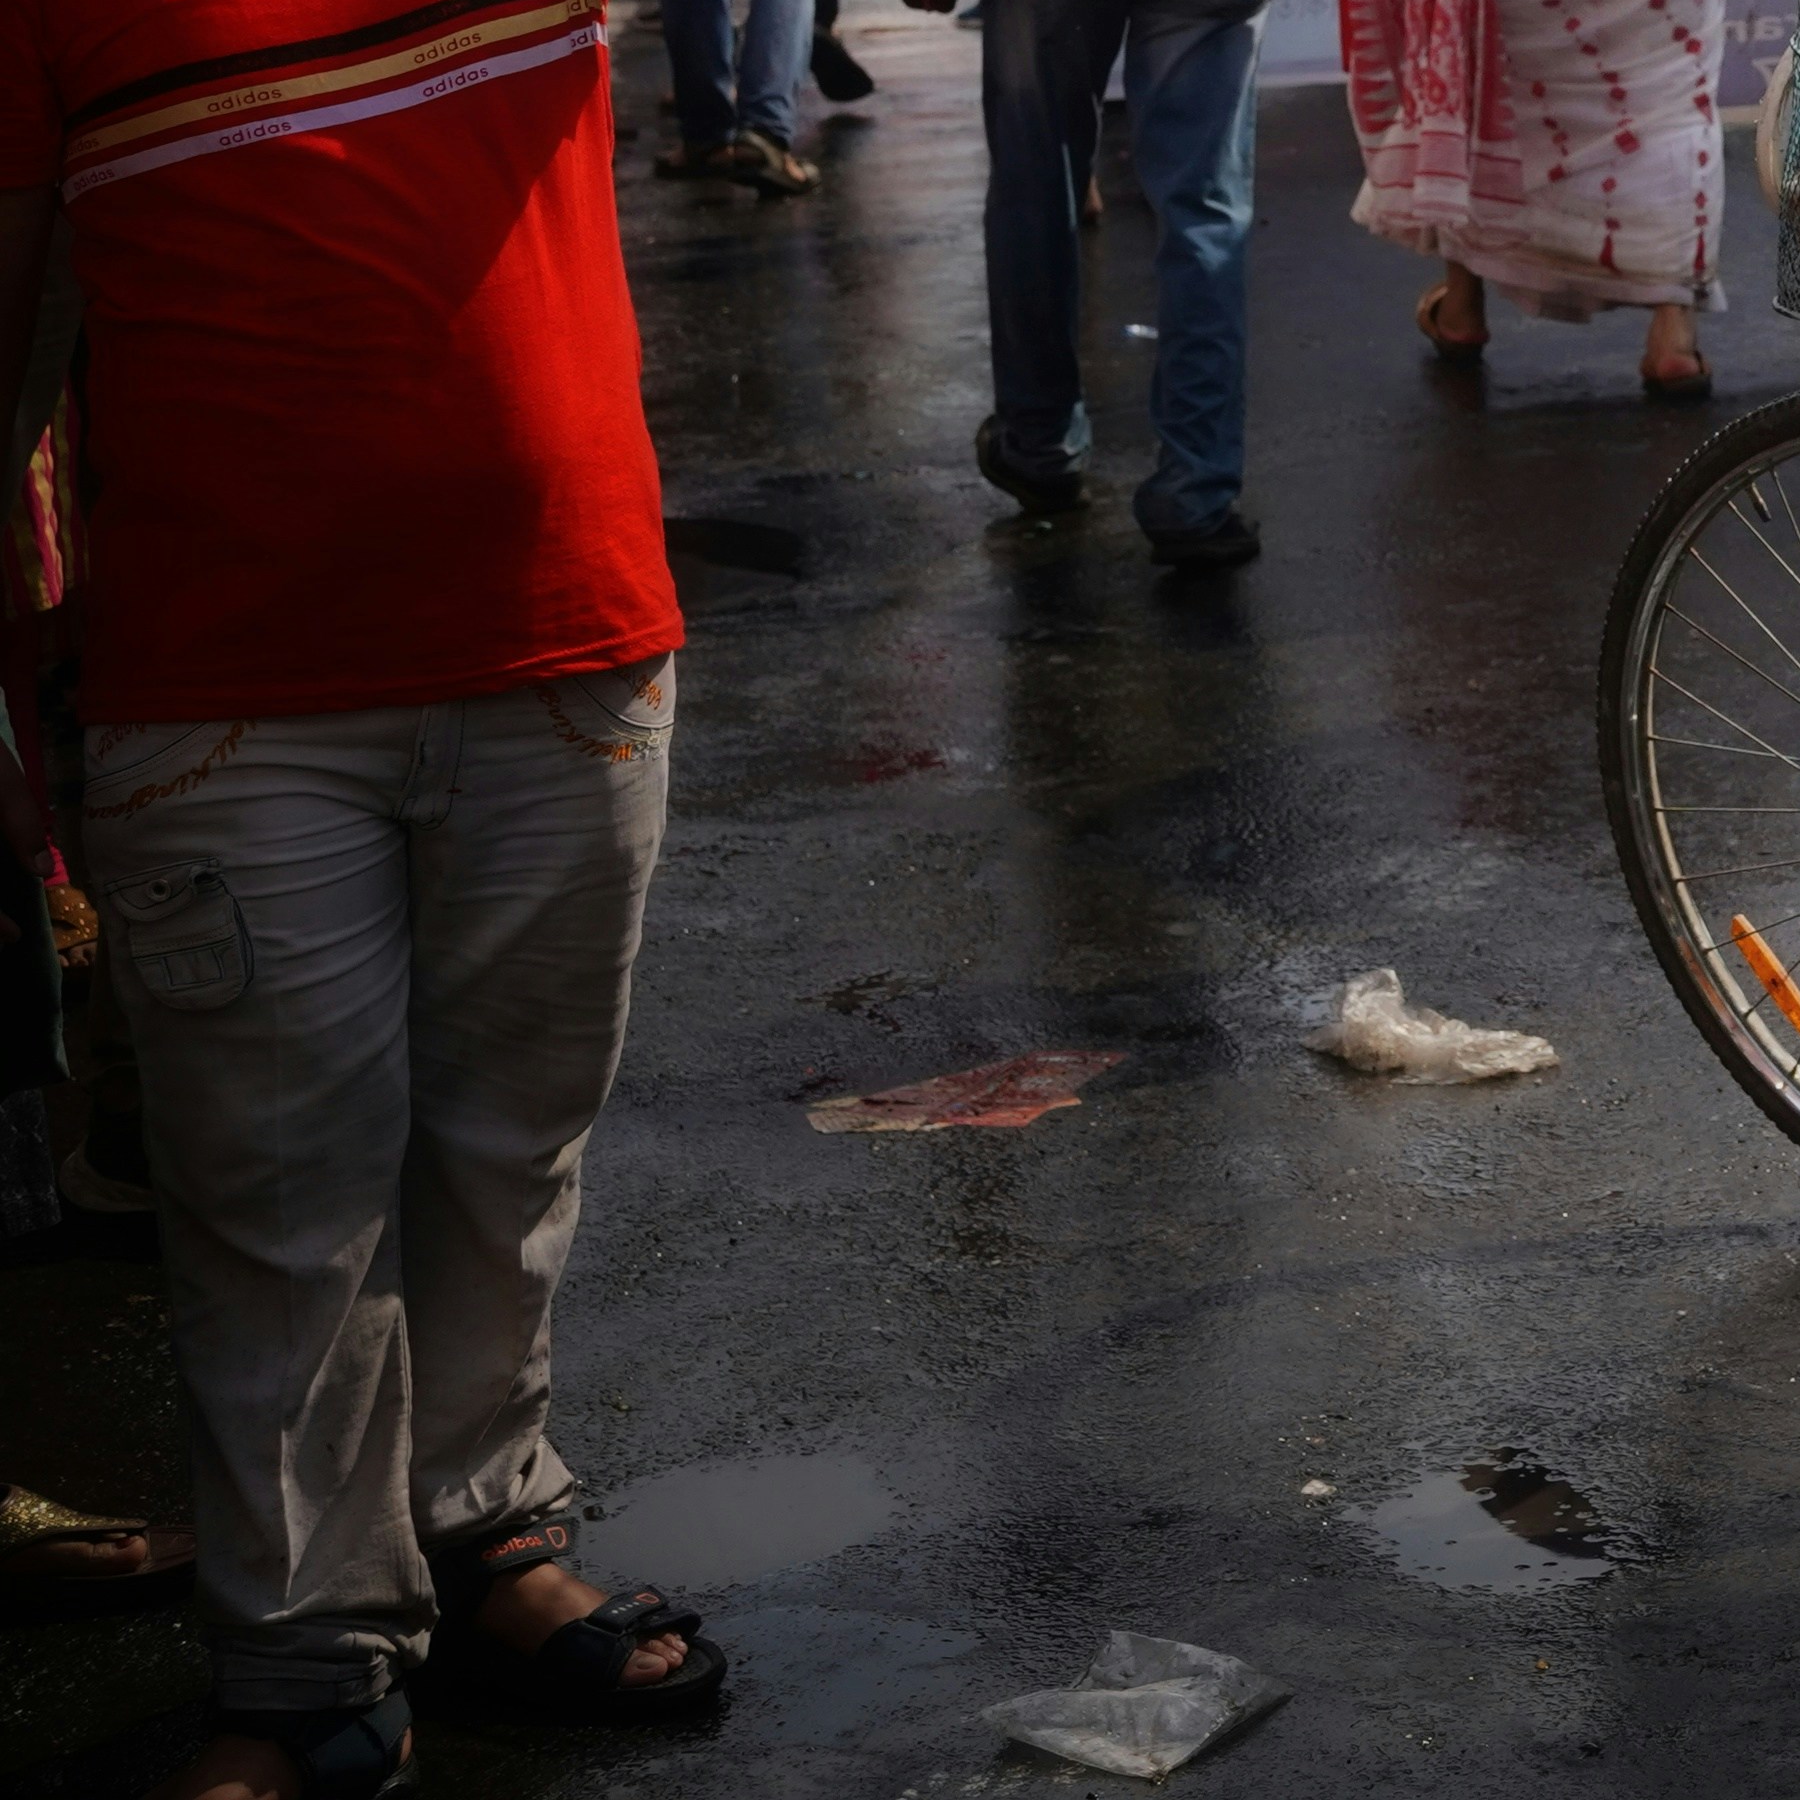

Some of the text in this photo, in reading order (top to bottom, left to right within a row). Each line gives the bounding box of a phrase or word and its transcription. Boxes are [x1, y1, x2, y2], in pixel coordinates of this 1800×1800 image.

[206, 86, 283, 115] adidas
[413, 30, 482, 66] adidas
[72, 167, 116, 192] adidas
[217, 119, 292, 148] adidas
[421, 65, 490, 99] adidas
